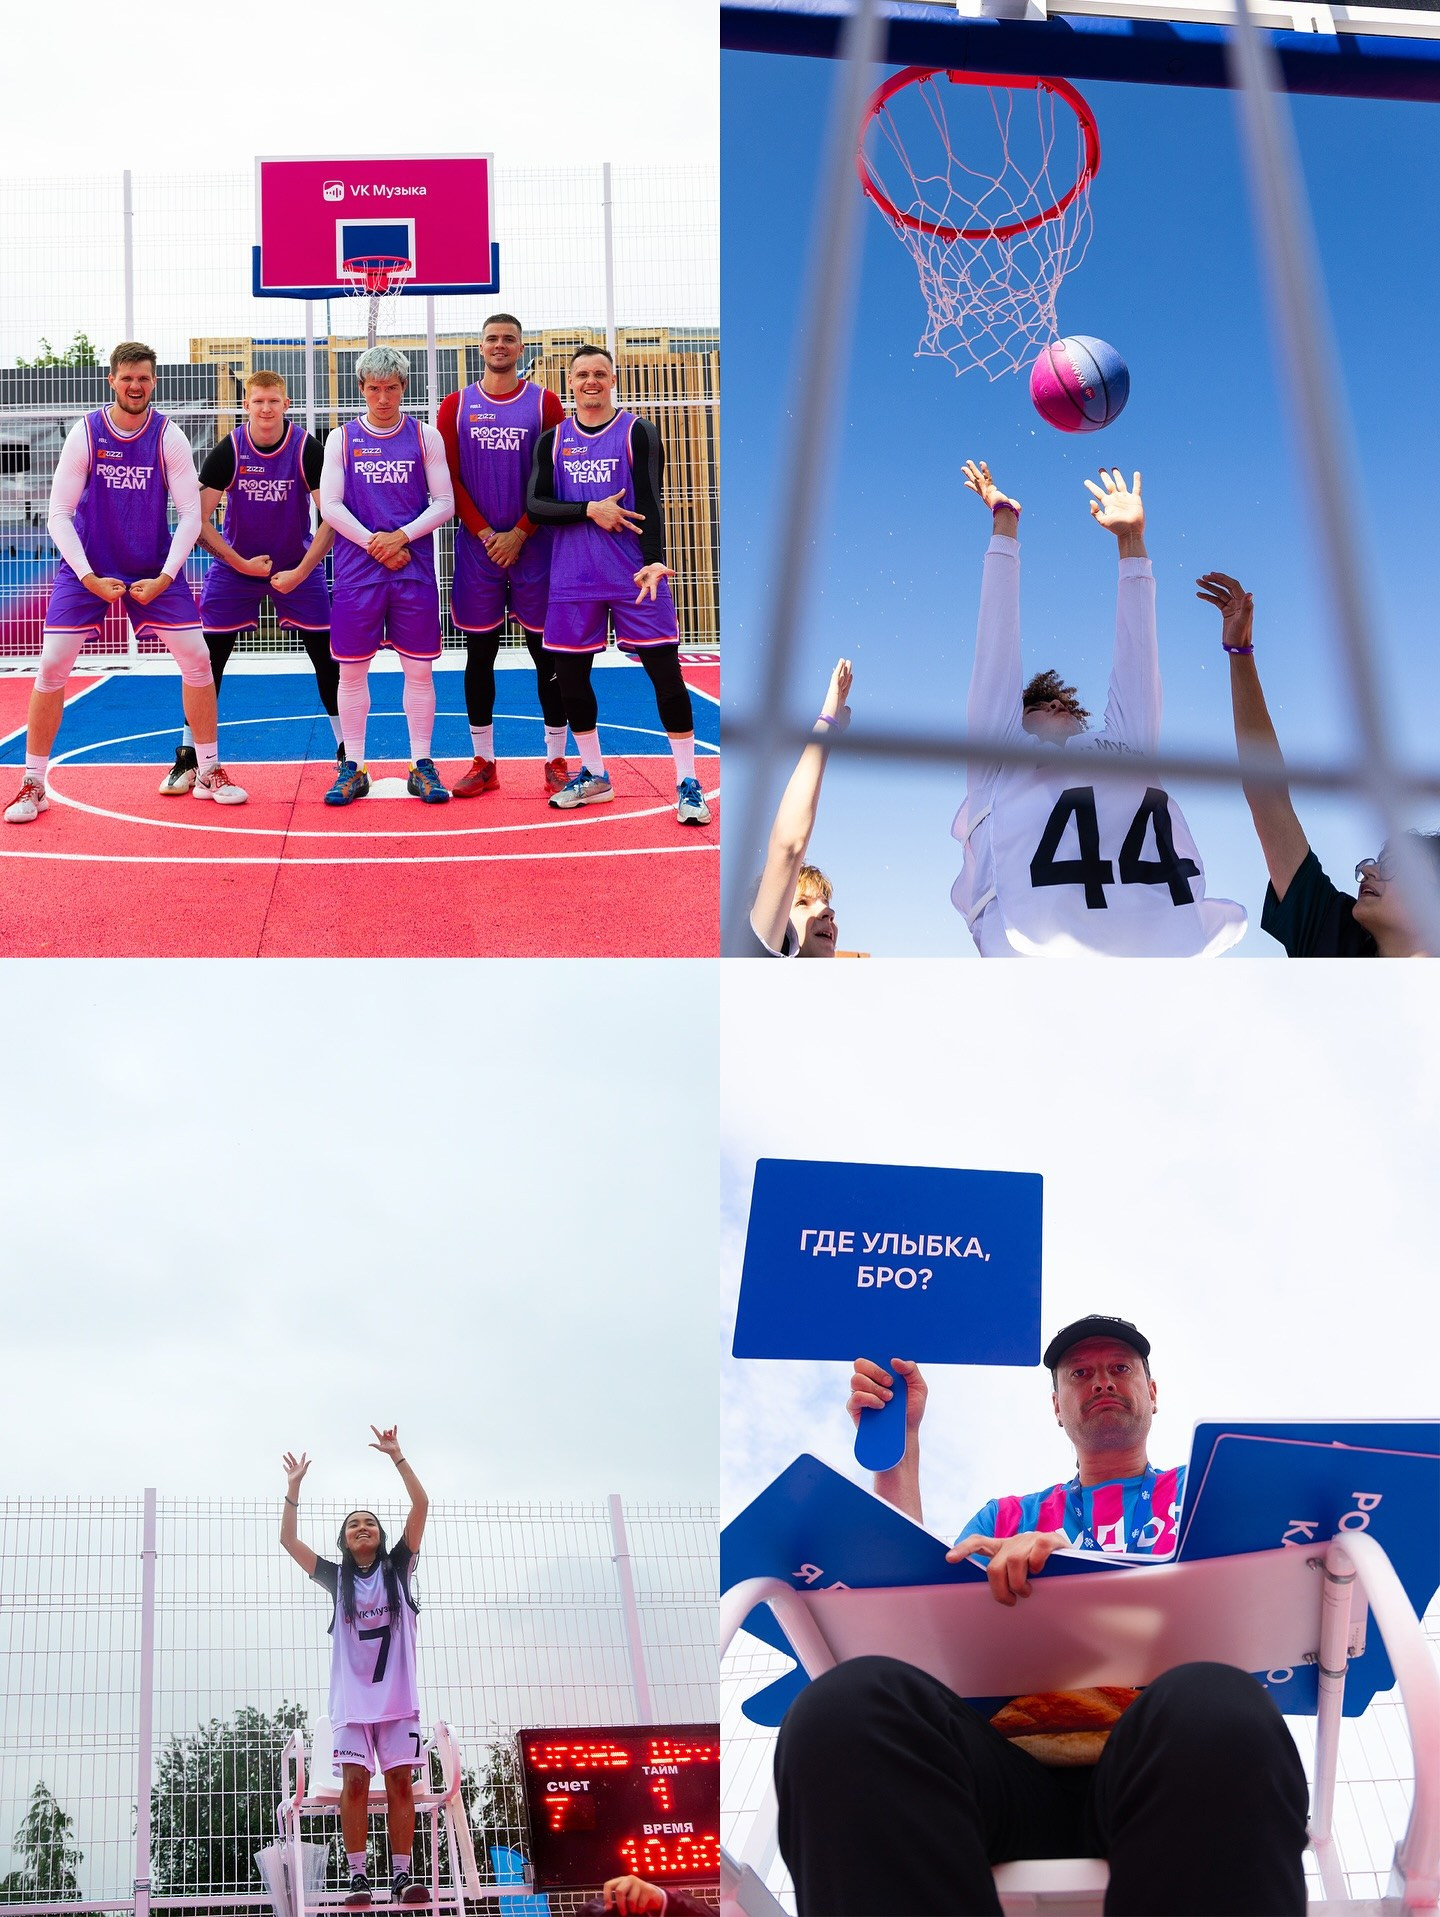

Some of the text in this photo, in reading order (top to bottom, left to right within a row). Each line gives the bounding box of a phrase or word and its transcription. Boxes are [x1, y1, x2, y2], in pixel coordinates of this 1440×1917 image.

[350, 184, 427, 199] VK Музыка
[470, 426, 529, 440] ROCKET
[478, 437, 520, 451] TEAM
[96, 463, 154, 479] ROCKET
[354, 460, 415, 473] ROCKET
[563, 458, 620, 472] ROCKET
[104, 476, 147, 490] TEAM
[362, 472, 408, 484] TEAM
[570, 470, 611, 484] TEAM
[238, 479, 295, 491] ROCKET
[245, 490, 288, 502] TEAM
[1030, 786, 1201, 909] 44
[800, 1229, 991, 1262] ГДЕ УЛЫБКА,
[857, 1265, 933, 1290] БРО?
[358, 1625, 391, 1684] 7
[408, 1732, 420, 1757] 7
[642, 1764, 679, 1776] ТАЙМ
[643, 1822, 694, 1835] ВРЕМЯ
